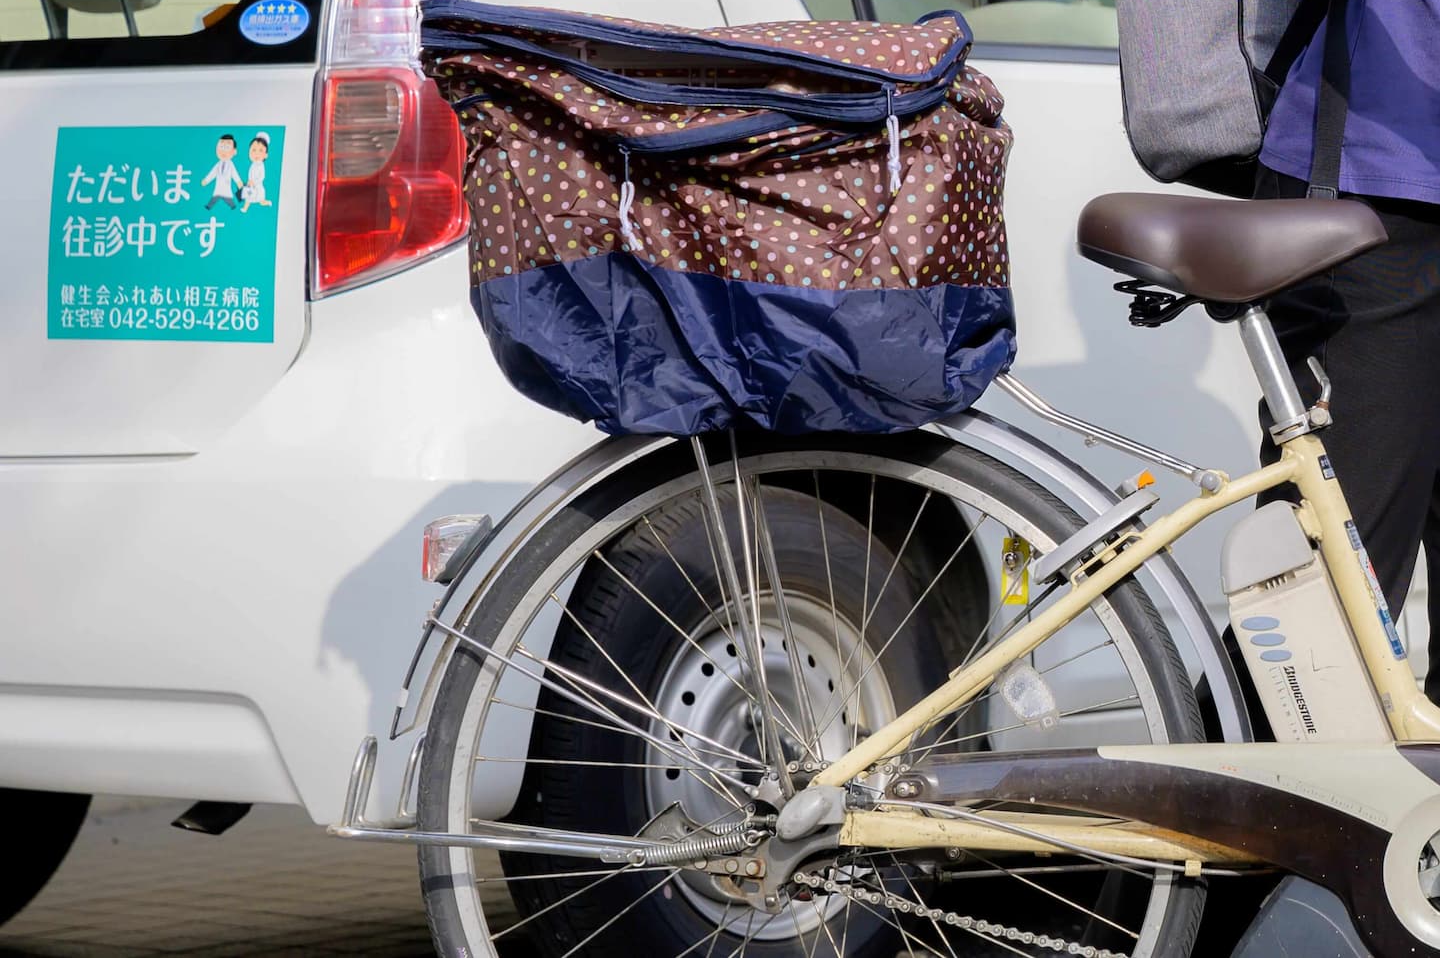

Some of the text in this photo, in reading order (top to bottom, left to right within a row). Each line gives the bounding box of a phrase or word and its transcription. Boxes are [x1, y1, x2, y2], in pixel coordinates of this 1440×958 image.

[66, 163, 192, 204] ただいま
[62, 215, 225, 258] 往診中です
[60, 284, 260, 308] 健生会ふれあい相互病院
[61, 307, 260, 331] 在宅室 042-529-4266
[1283, 665, 1317, 734] BRIDGESTONE
